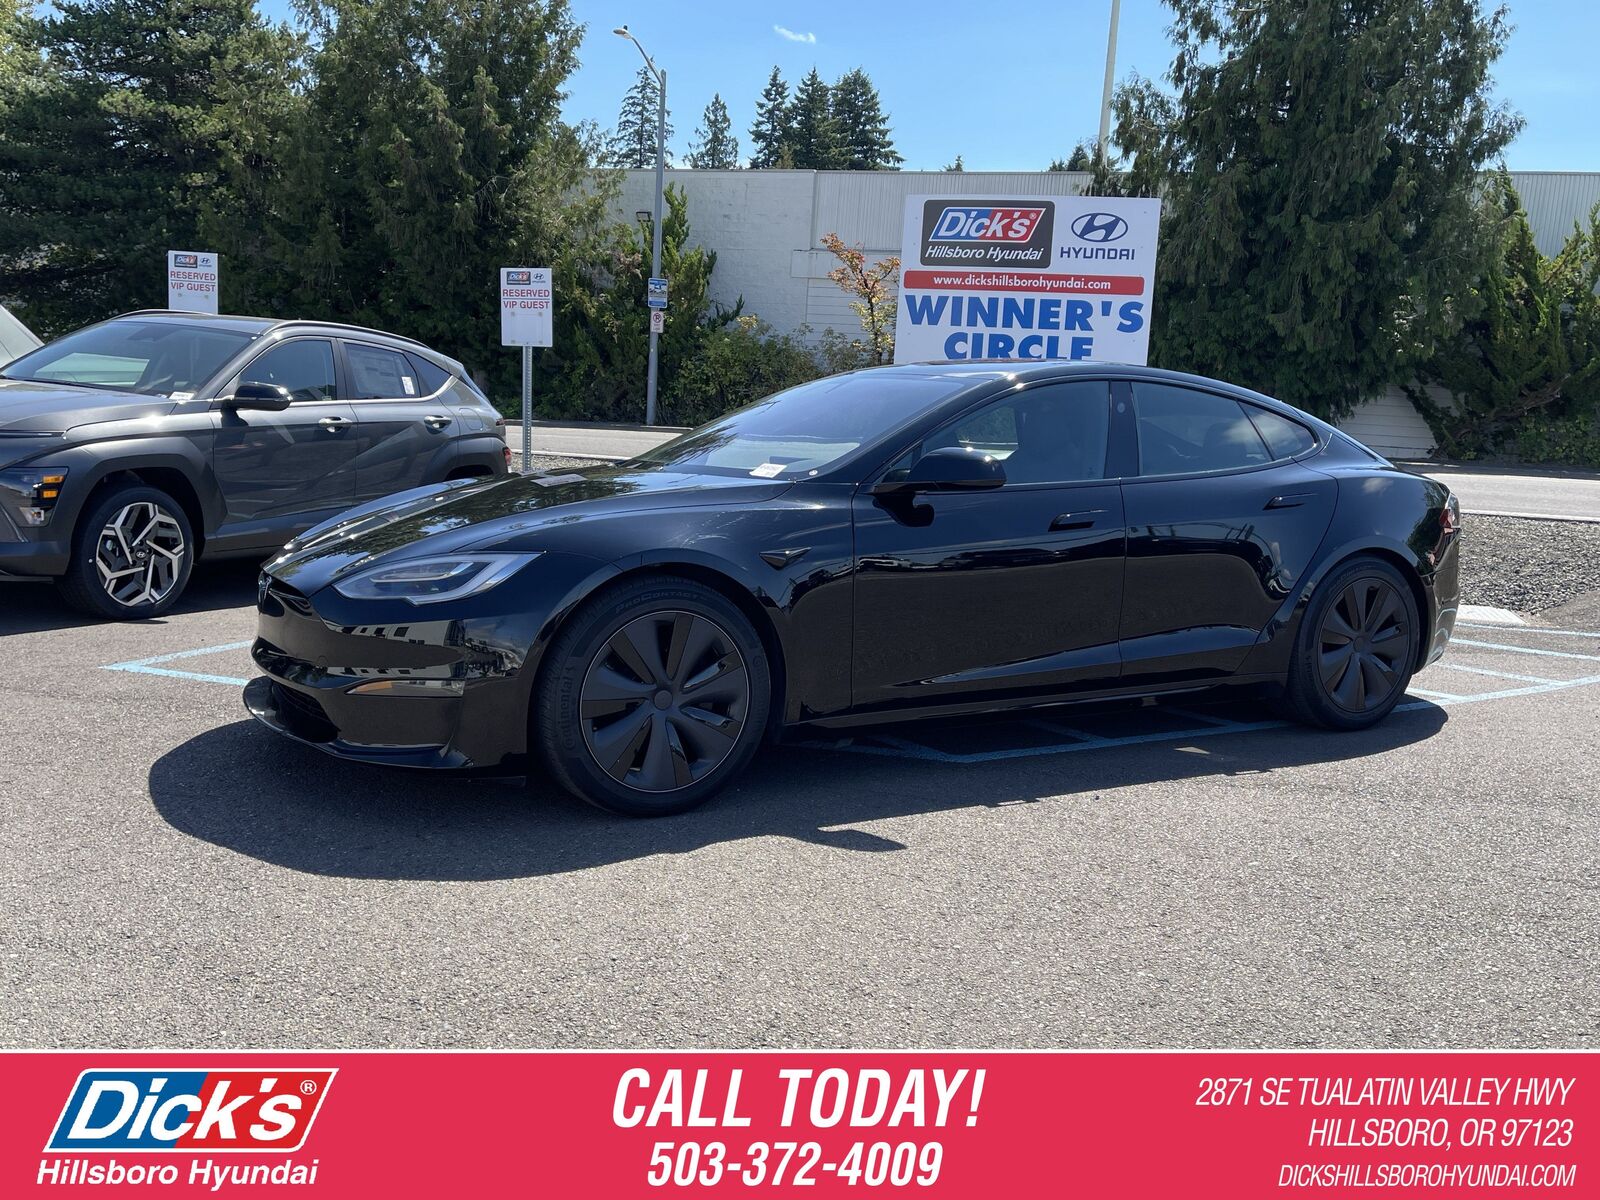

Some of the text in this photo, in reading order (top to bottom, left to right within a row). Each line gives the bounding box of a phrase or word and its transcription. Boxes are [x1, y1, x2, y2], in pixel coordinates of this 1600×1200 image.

[937, 211, 1031, 238] Dick's
[925, 245, 1043, 262] Hillsboro Hyundai
[1060, 246, 1135, 260] HYUNDAI
[170, 271, 216, 281] RESERVED
[933, 274, 1111, 290] www.dickshillsborohyundai.com
[171, 282, 216, 292] VIP GUEST
[502, 289, 550, 298] RESERVED
[520, 301, 550, 309] GUEST
[905, 295, 1144, 333] WINNER'S
